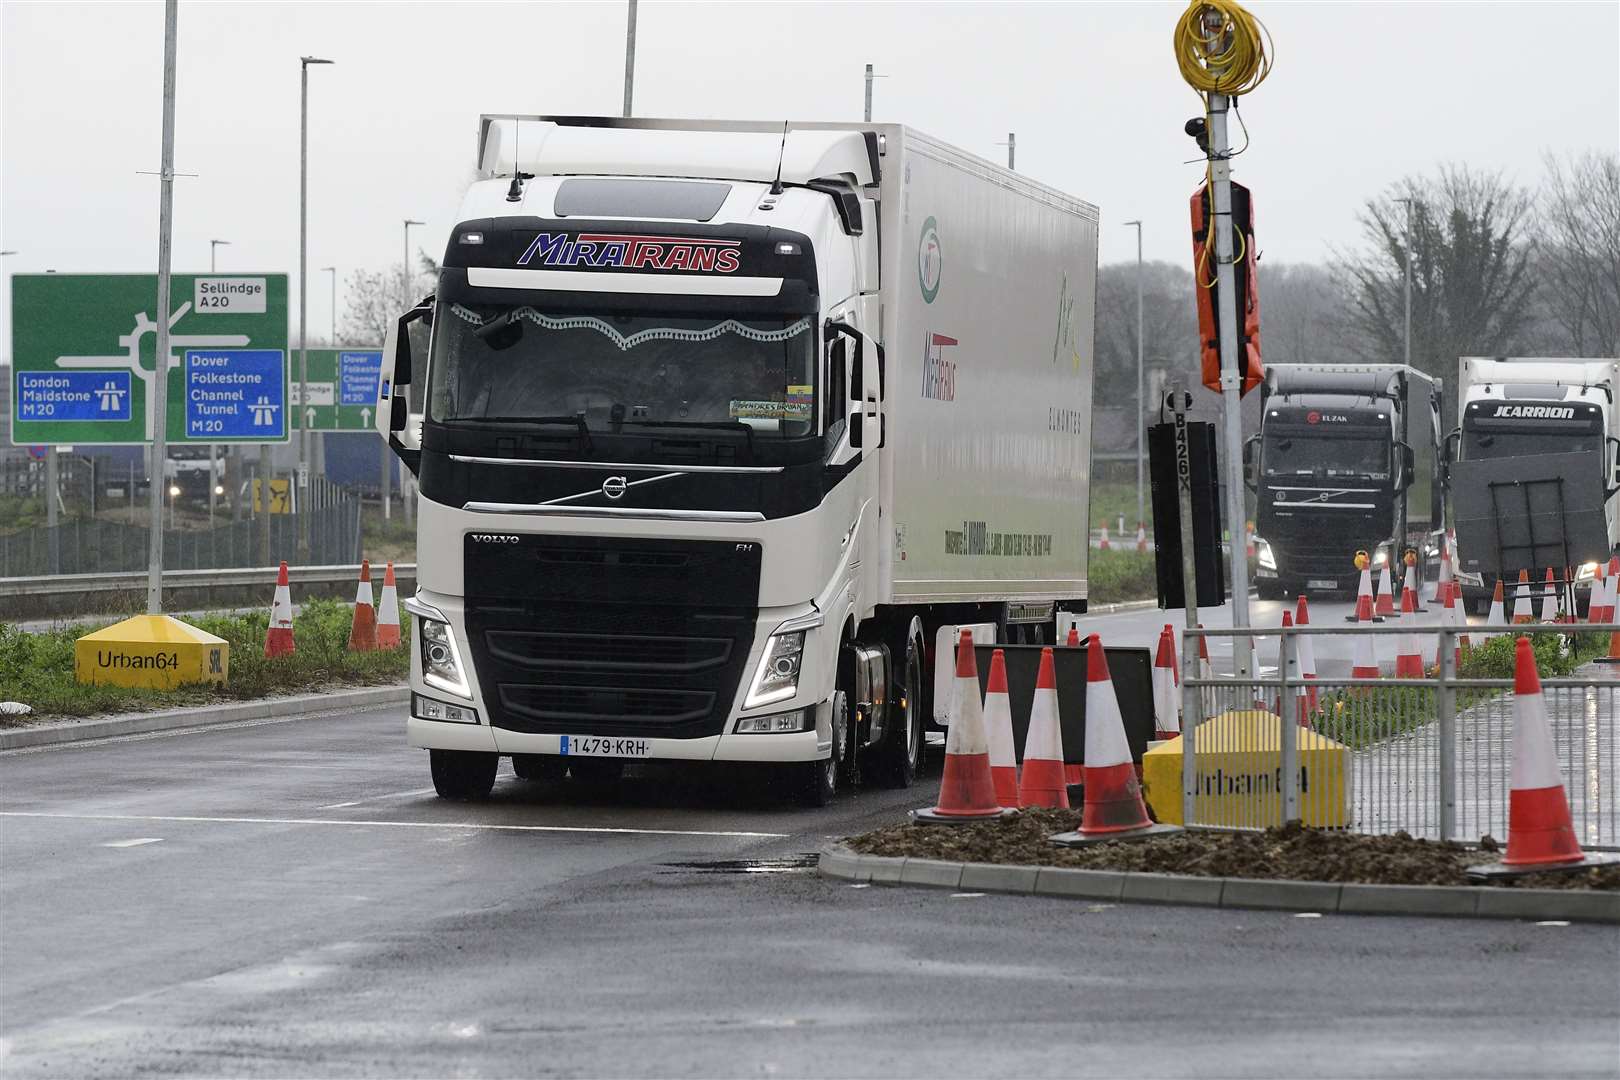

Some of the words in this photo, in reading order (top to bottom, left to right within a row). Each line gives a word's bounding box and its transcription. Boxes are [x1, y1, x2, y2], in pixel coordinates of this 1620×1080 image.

[517, 233, 742, 272] MIRATRANS
[200, 282, 262, 295] Sellindge
[200, 297, 229, 307] A20
[192, 355, 229, 366] Dover
[23, 376, 70, 388] London
[192, 372, 262, 384] Folkestone
[23, 390, 91, 402] Maidstone
[191, 389, 244, 401] Channel
[23, 404, 55, 416] M20
[196, 403, 239, 415] Tunnel
[1493, 405, 1575, 419] JCARRION
[192, 420, 223, 432] M20
[471, 534, 520, 544] VOLVO
[736, 544, 753, 552] FH
[98, 650, 179, 670] Urban64
[573, 738, 611, 754] 1479
[616, 740, 645, 755] KRH
[1181, 766, 1309, 797] rban4
